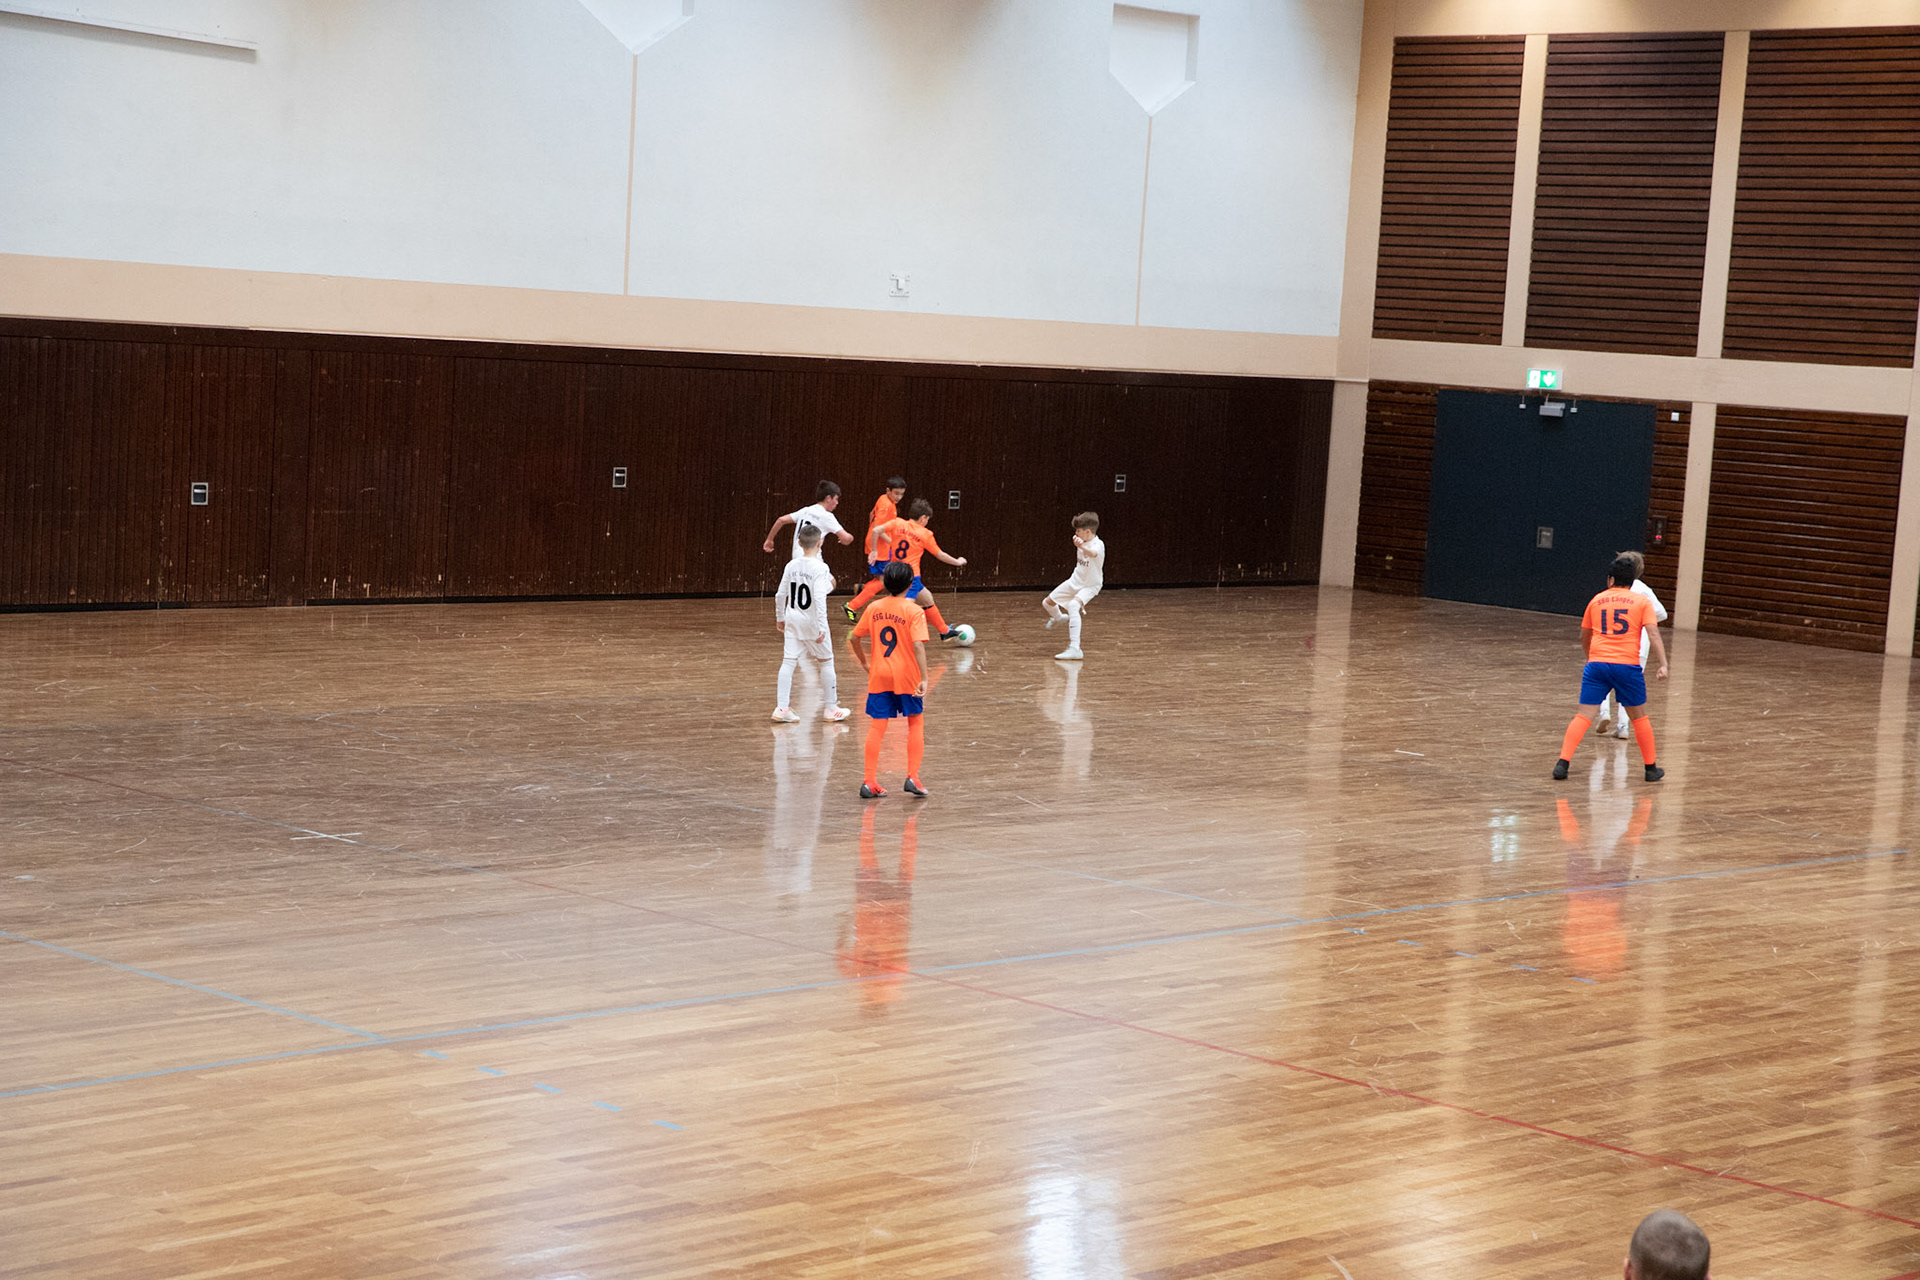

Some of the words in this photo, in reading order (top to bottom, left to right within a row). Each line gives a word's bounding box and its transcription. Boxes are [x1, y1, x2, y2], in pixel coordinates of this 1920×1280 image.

[895, 540, 909, 560] 8
[790, 582, 811, 610] 10
[885, 612, 906, 625] Langen
[1601, 609, 1629, 634] 15
[880, 626, 897, 658] 9
